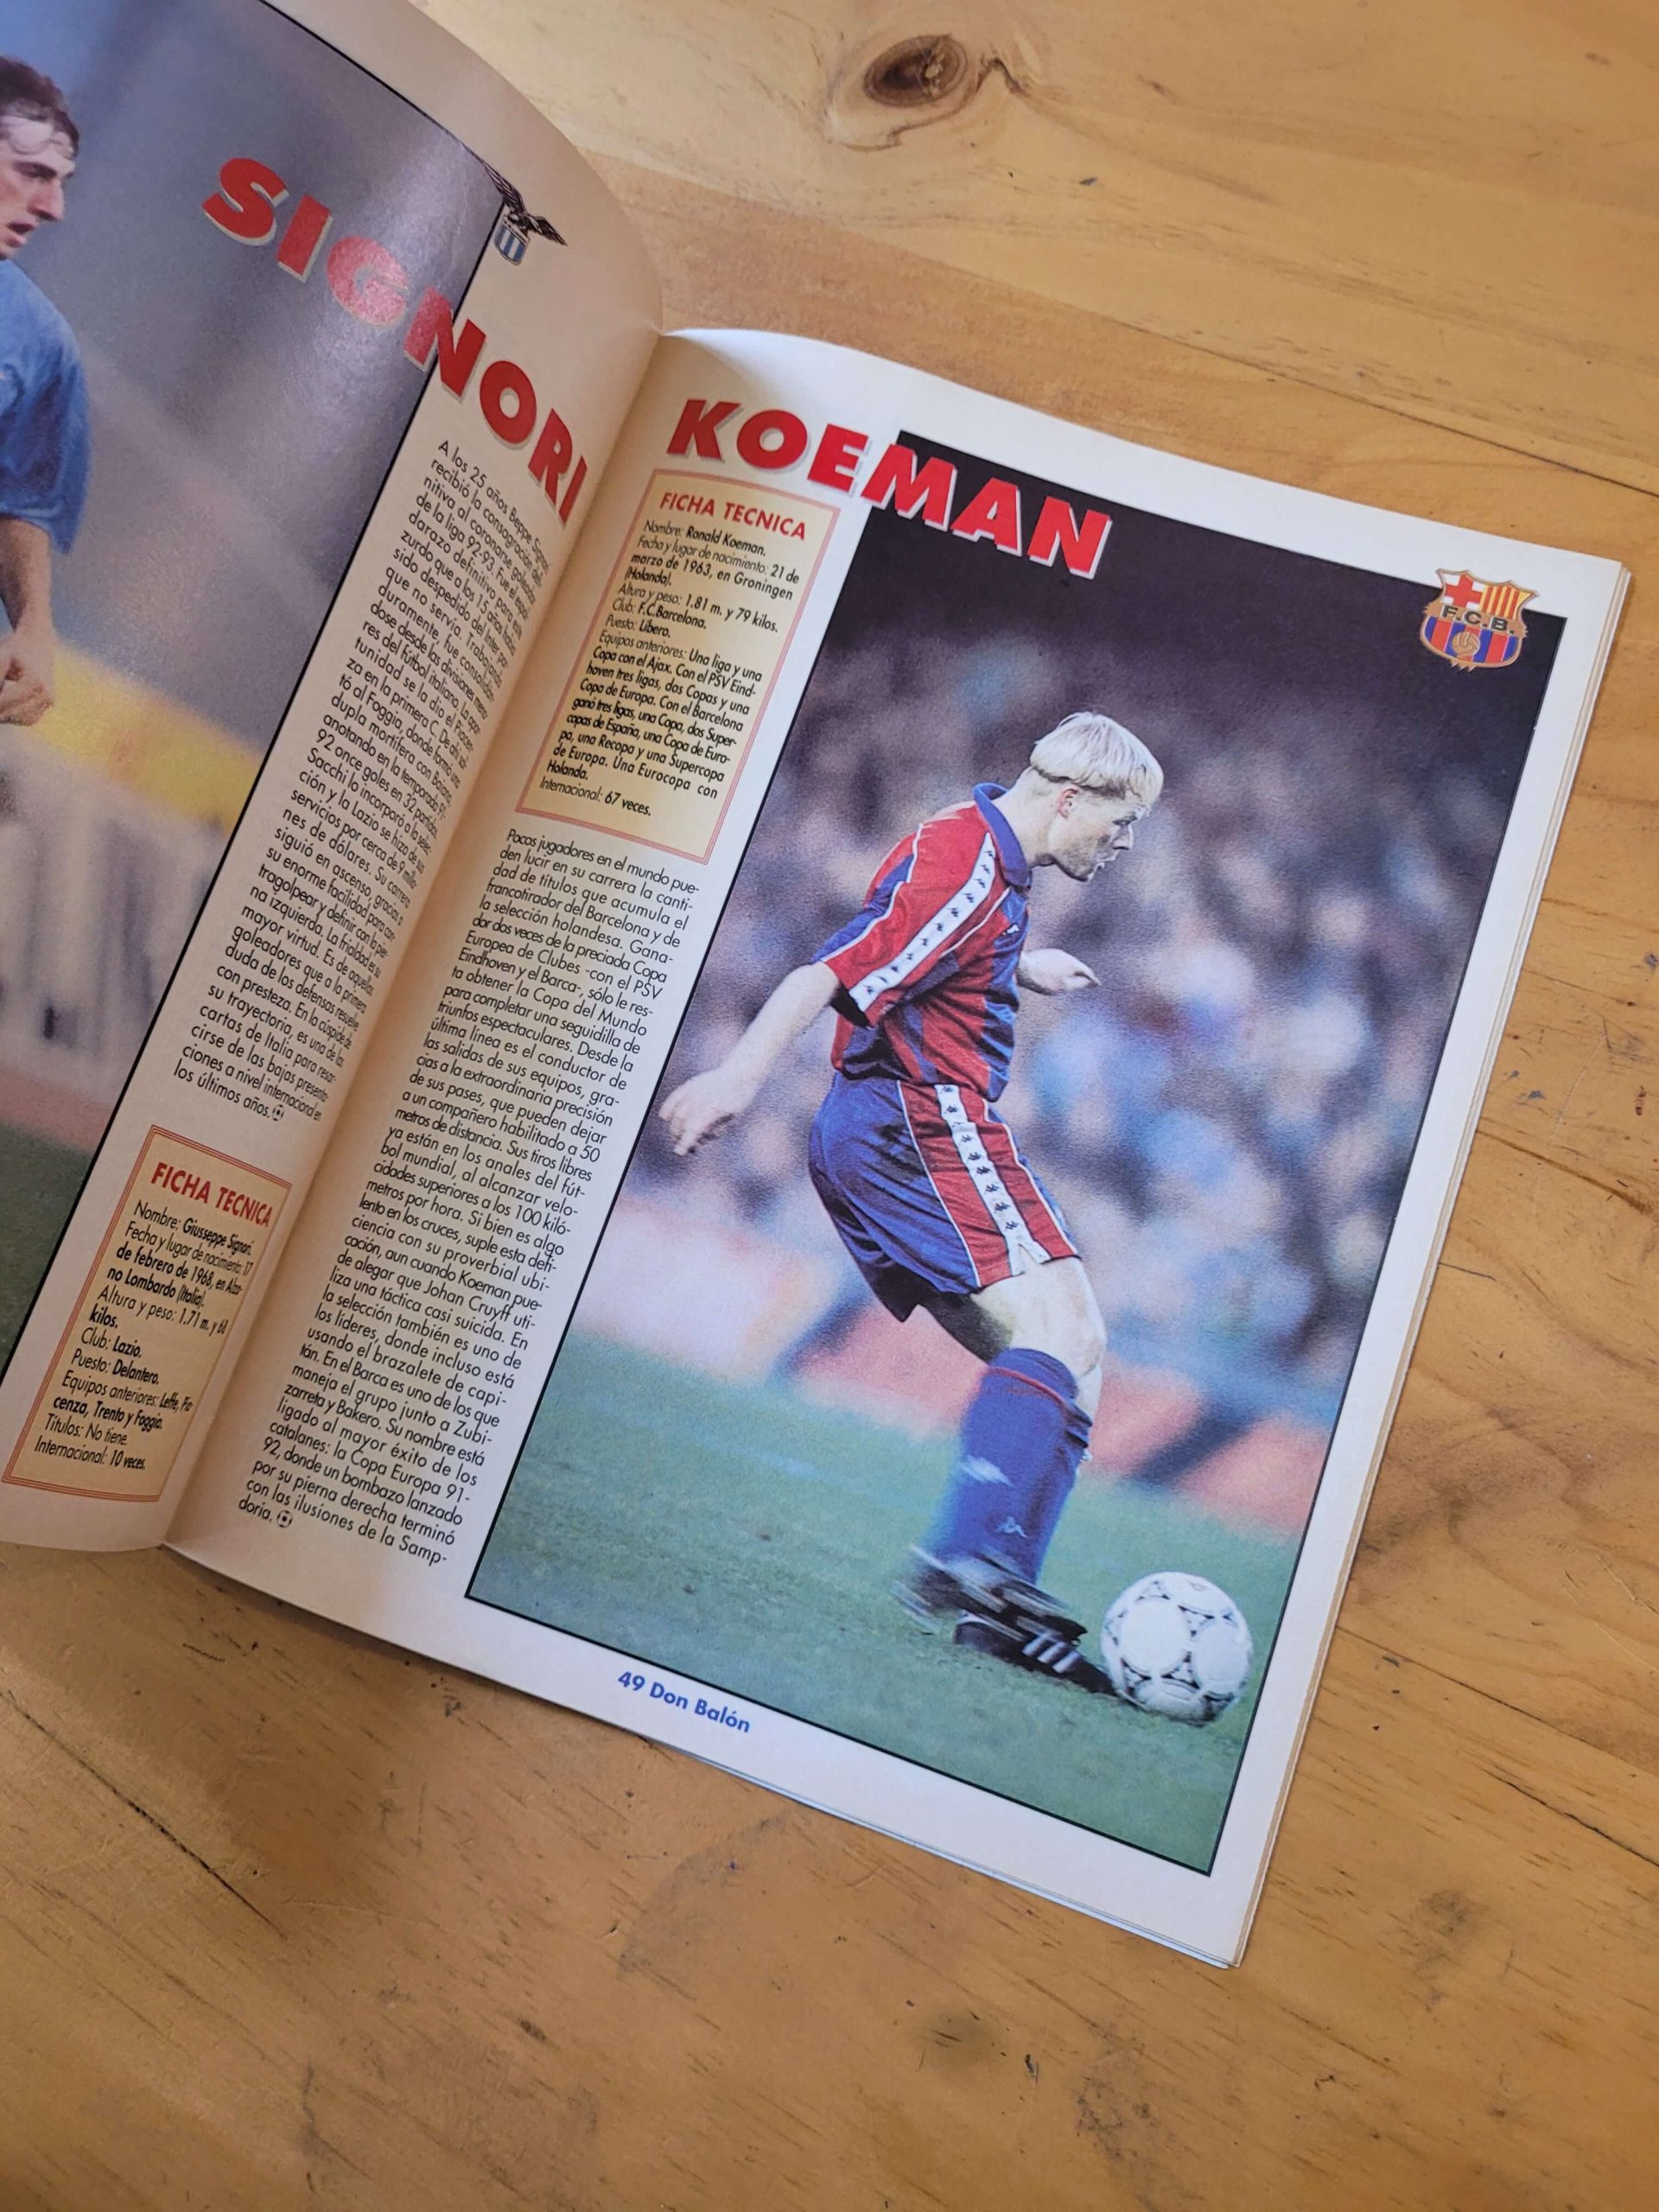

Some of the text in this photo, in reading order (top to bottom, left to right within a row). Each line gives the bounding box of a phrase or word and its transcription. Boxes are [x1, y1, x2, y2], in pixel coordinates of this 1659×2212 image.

[202, 157, 589, 527] SIGNORI
[438, 440, 532, 544] A los 25 años Beppe
[666, 398, 1112, 580] KOEMAN
[416, 492, 499, 575] de la liga 92-93.
[643, 519, 766, 556] Nombre: Ronald Koeman.
[660, 492, 805, 539] FICHA TECNICA
[631, 554, 793, 600] marzo de 1963, en Groningen
[637, 535, 664, 550] Fecha
[671, 538, 697, 562] lugar
[698, 544, 712, 560] de
[712, 551, 766, 574] nacimiento:
[770, 564, 785, 579] 21
[785, 569, 799, 584] de
[605, 613, 635, 631] Puesto:
[612, 597, 706, 629] Club: F.C.Barcelona.
[618, 582, 646, 598] Altura
[652, 592, 682, 607] peso:
[685, 594, 709, 611] 1.81
[709, 604, 722, 615] m.
[735, 607, 752, 622] 79
[752, 611, 778, 632] kilos.
[590, 645, 755, 697] Copa con el Ajax. Con el PSV Eind-
[598, 629, 634, 649] Equipos
[635, 639, 687, 658] anteriores:
[689, 648, 710, 665] Una
[711, 653, 732, 677] liga
[741, 668, 762, 682] una
[316, 728, 417, 813] 92 once goles en 32
[546, 760, 591, 779] Holanda.
[553, 741, 718, 799] de Europa. Una Eurocopa con
[557, 730, 575, 744] pa,
[577, 734, 597, 745] una
[598, 734, 635, 756] Recopa
[646, 750, 667, 764] una
[669, 753, 724, 783] Supercopa
[539, 776, 651, 817] Internacional: 67 veces.
[493, 861, 690, 931] dad de títulos que acumula el
[451, 965, 647, 1036] ta obtener la Copa del Mundo
[200, 1006, 318, 1072] cartas de Italia para
[402, 1091, 601, 1163] a un compañero habilitado a 50
[151, 1162, 272, 1226] FICHA TECNICA
[133, 1199, 227, 1249] Nombre: Giusseppe
[106, 1268, 176, 1298] no Lombardo
[116, 1241, 214, 1290] de febrero de 1968,
[337, 1248, 535, 1330] de alegar que Johan Cruyff uti-
[89, 1304, 118, 1329] kilos.
[97, 1285, 201, 1327] Altura y peso: 1.71
[71, 1348, 159, 1384] Puesto: Delantero.
[81, 1326, 142, 1358] Club: Lazio.
[308, 1319, 506, 1407] usando el brazalete de capi-
[45, 1413, 84, 1437] Títulos:
[85, 1422, 103, 1441] No
[53, 1396, 89, 1418] cenza,
[93, 1401, 125, 1422] Trento
[35, 1435, 107, 1464] Internacional:
[110, 1450, 124, 1467] 10
[276, 1391, 478, 1486] ligado al mayor éxito de los
[251, 1460, 454, 1545] por su pierna derecha terminó
[617, 1671, 750, 1733] 49 Don Balón
